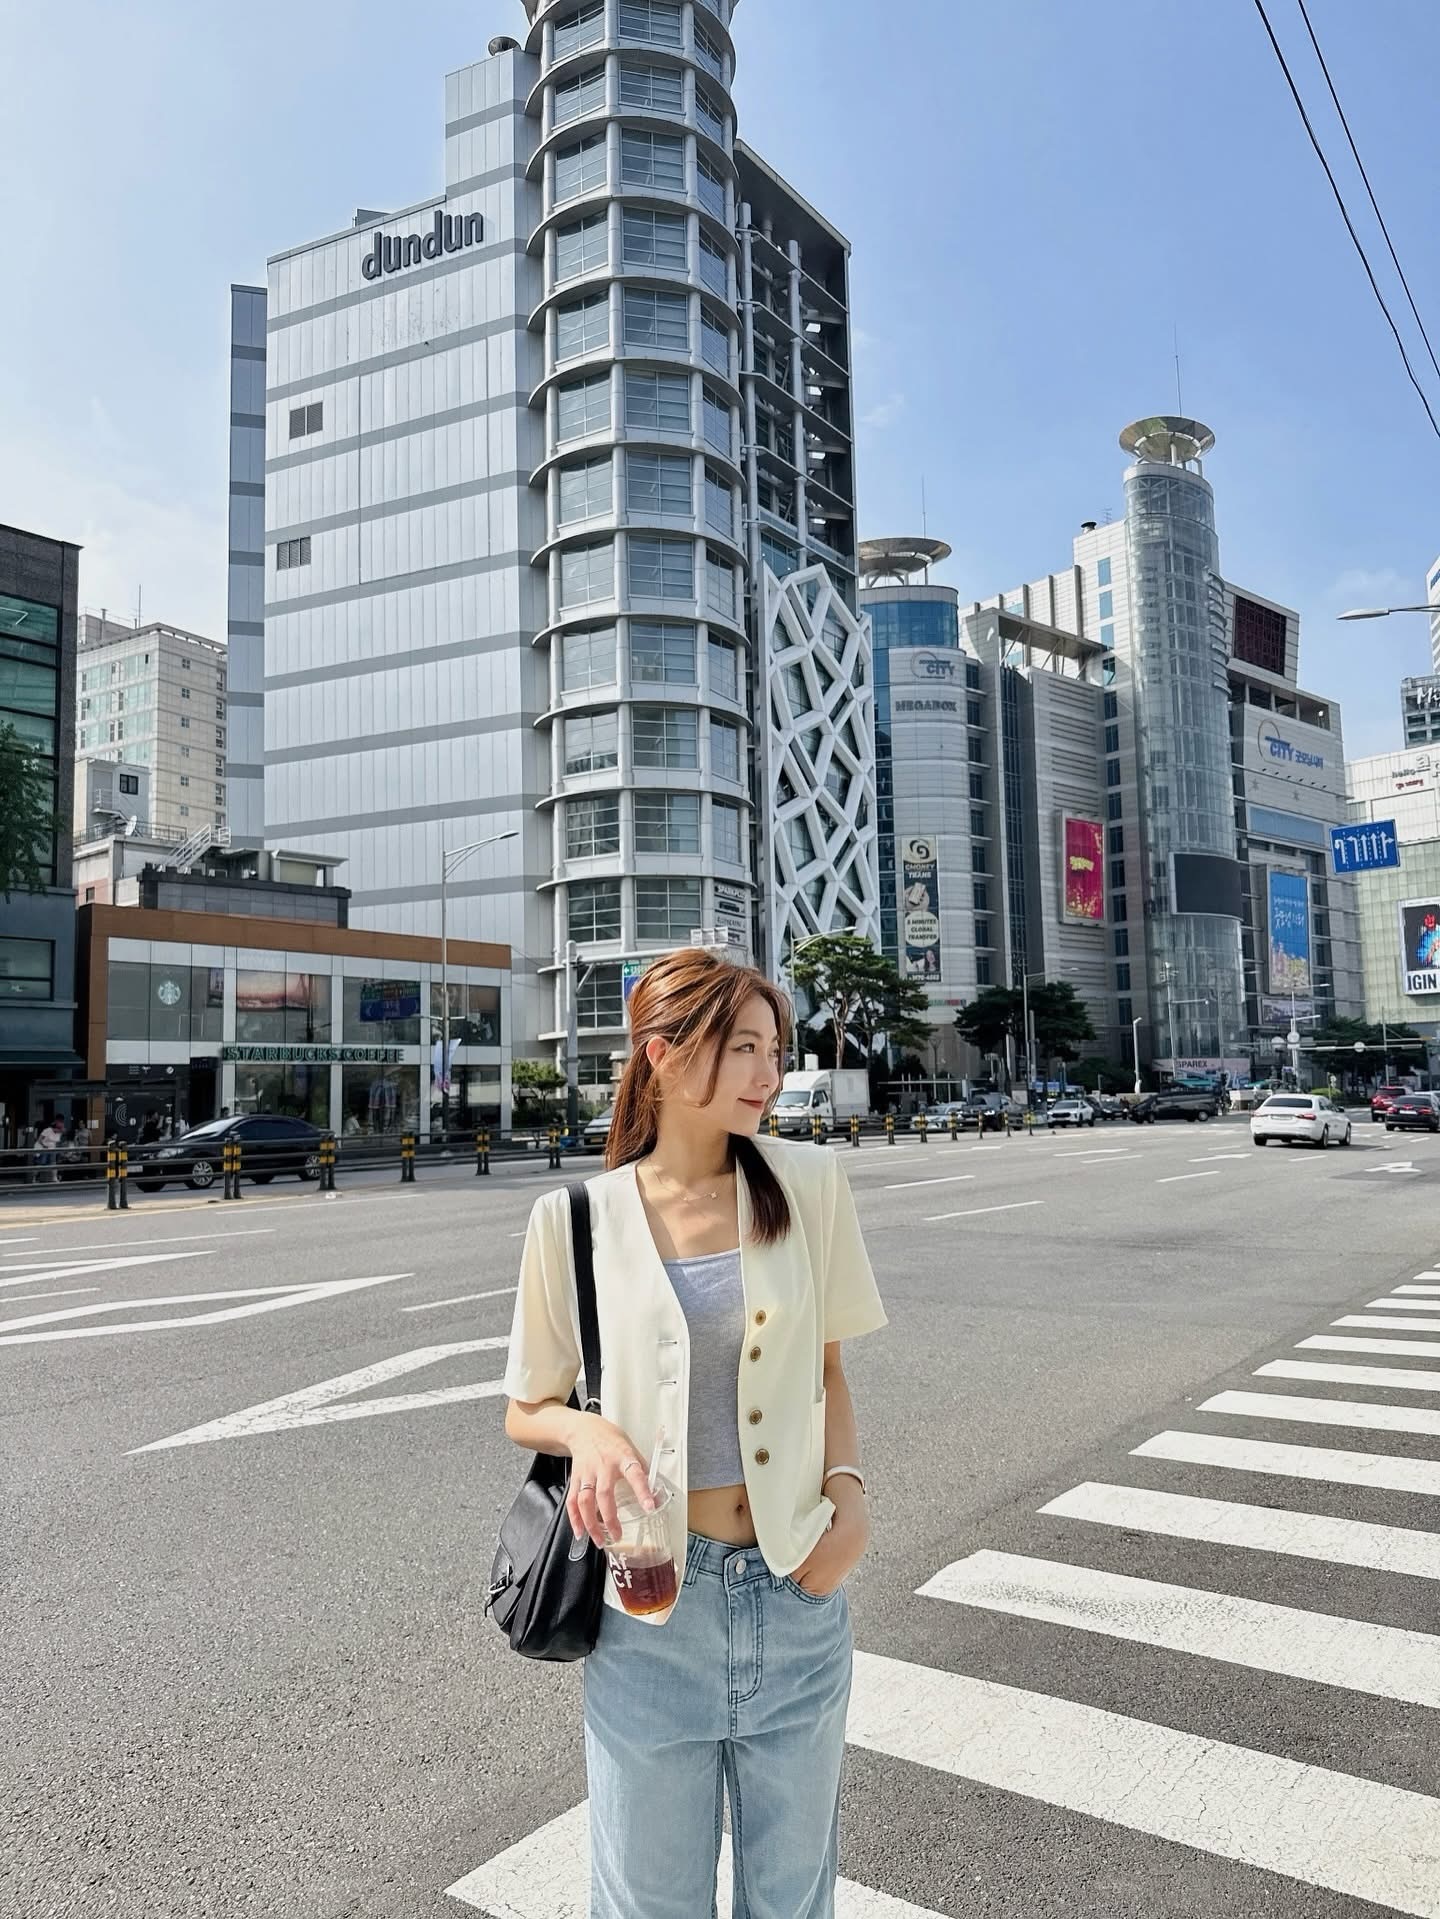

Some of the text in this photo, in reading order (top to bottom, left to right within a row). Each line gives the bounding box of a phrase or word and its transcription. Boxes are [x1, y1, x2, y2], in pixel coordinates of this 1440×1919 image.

[361, 209, 484, 280] dundun
[926, 663, 955, 676] CITY
[895, 700, 957, 713] MEGABOX
[1270, 741, 1295, 762] CITY
[225, 1046, 405, 1063] STARBUCKS COFFEE
[1175, 1060, 1207, 1068] SPAREX
[608, 1551, 627, 1570] Af
[613, 1569, 633, 1589] Cf
